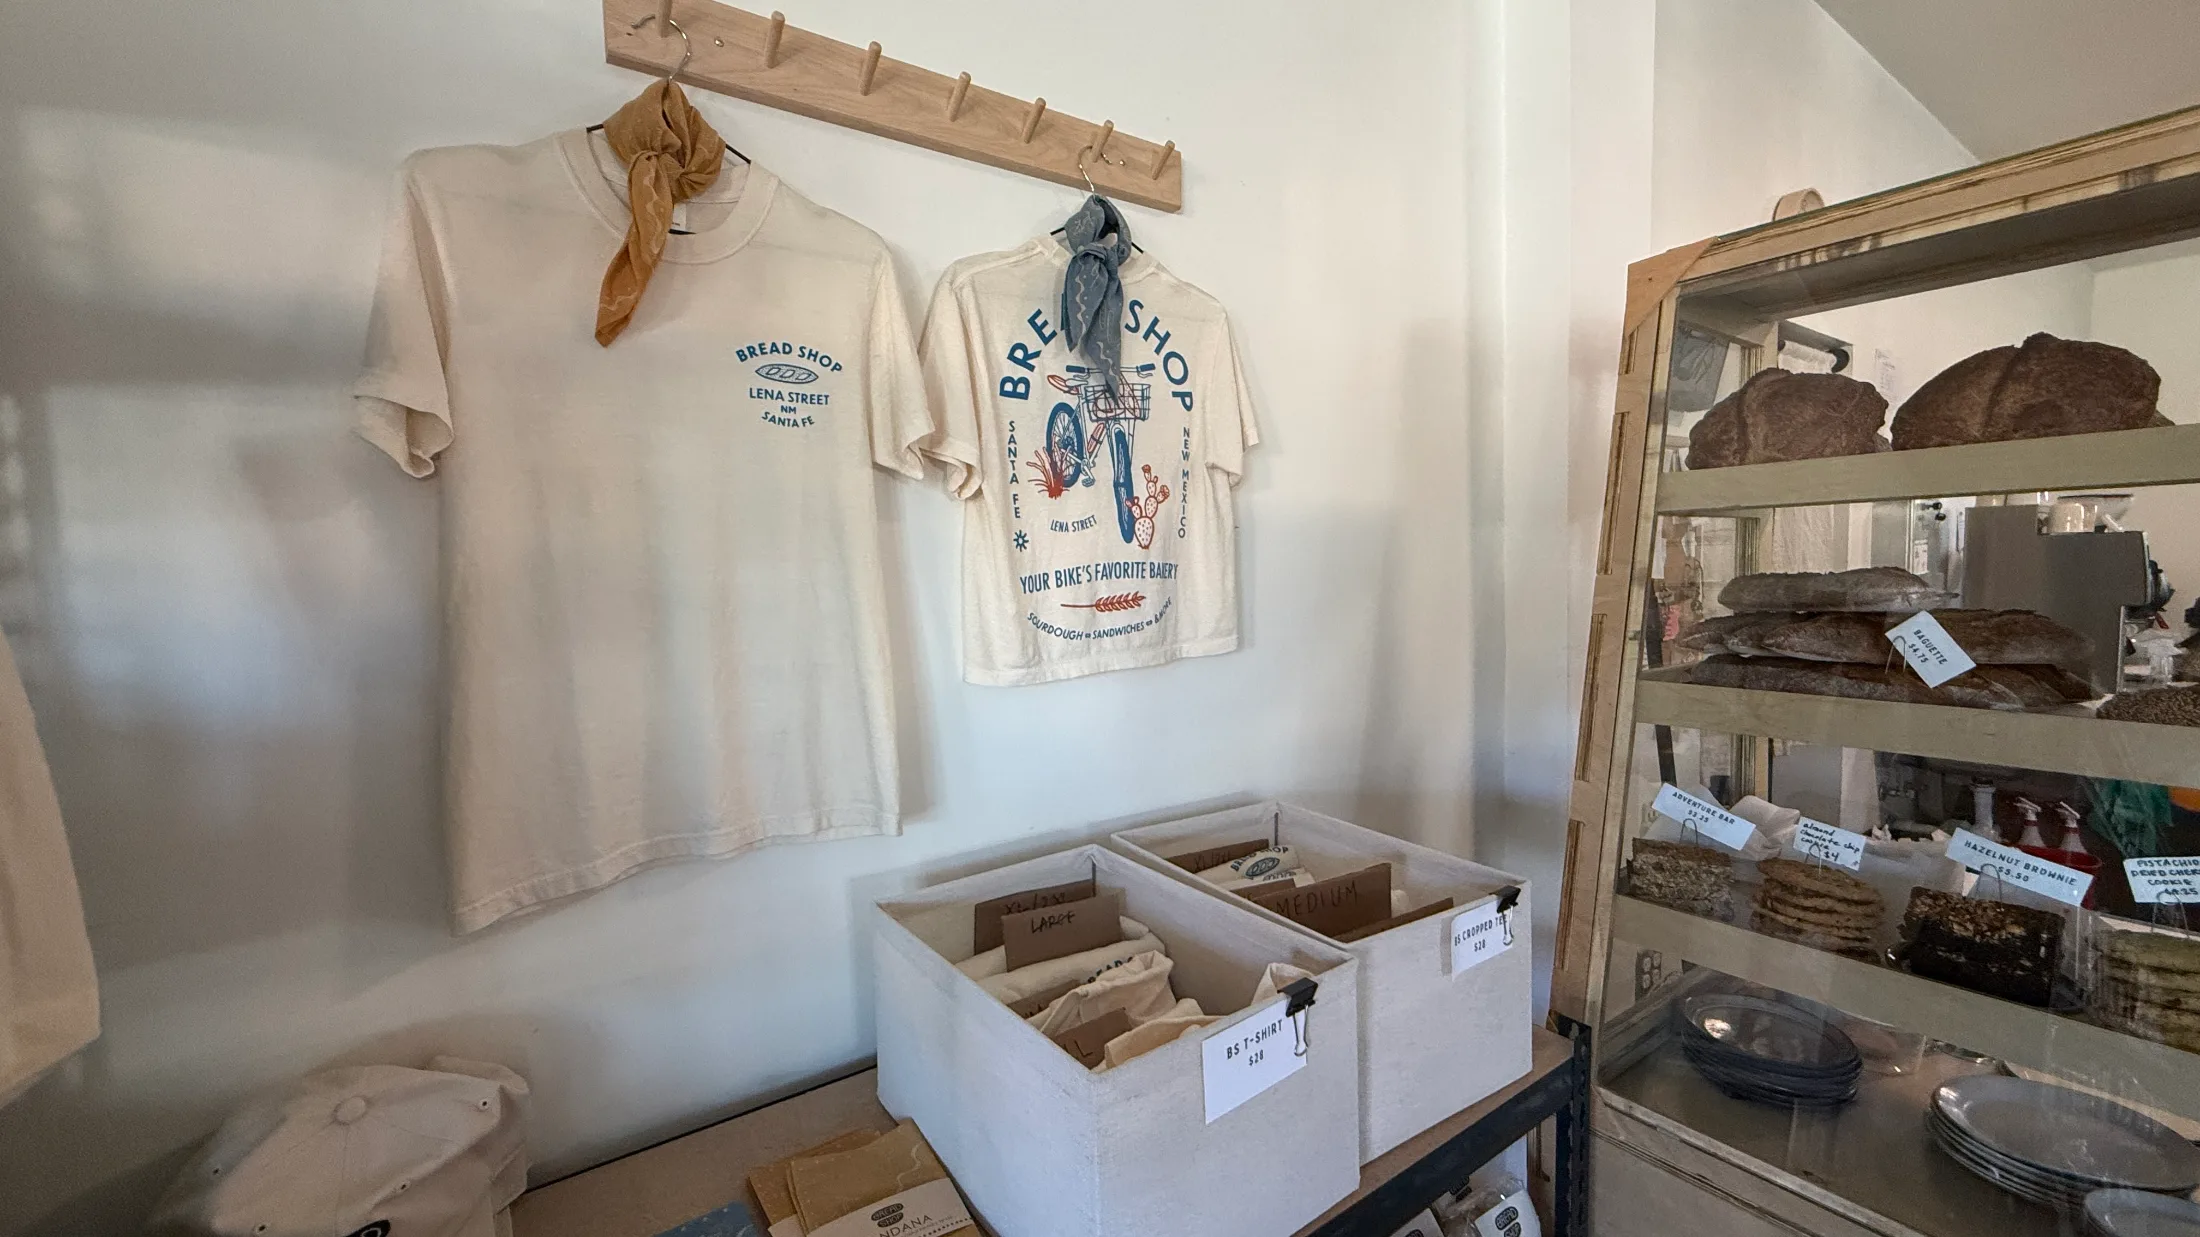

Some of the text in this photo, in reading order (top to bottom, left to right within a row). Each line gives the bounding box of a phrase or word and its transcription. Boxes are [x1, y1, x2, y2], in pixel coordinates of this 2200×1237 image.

[735, 342, 843, 373] BREAD SHOP
[1000, 299, 1194, 412] BRE SHOP
[749, 387, 830, 405] LENA STREET
[780, 405, 797, 414] NM
[762, 411, 815, 428] SANTA FE
[1007, 420, 1021, 519] SANTA FE
[1178, 427, 1191, 539] NEW MEXICO
[1050, 514, 1098, 533] LENA STREET
[1020, 571, 1051, 594] YOUR
[1054, 564, 1093, 588] BIKE'S
[1094, 561, 1146, 582] FAVORITE
[1026, 612, 1084, 641] SOURDOUGH
[1092, 622, 1145, 640] SANDWICHES
[1908, 643, 1930, 663] $4.75
[1913, 629, 1949, 665] BAGUETTE
[1672, 791, 1736, 825] ADVENTURE BAR
[1964, 840, 2078, 886] HAZELNUT BROWNIE
[1998, 866, 2030, 882] $5.50
[2136, 858, 2200, 867] PISTACHIO
[1276, 879, 1358, 919] MEDIUM
[1462, 920, 1493, 941] CROPPED
[1474, 938, 1486, 952] $28
[1226, 1019, 1283, 1060] BS T-SHIRT
[1248, 1049, 1264, 1067] $28
